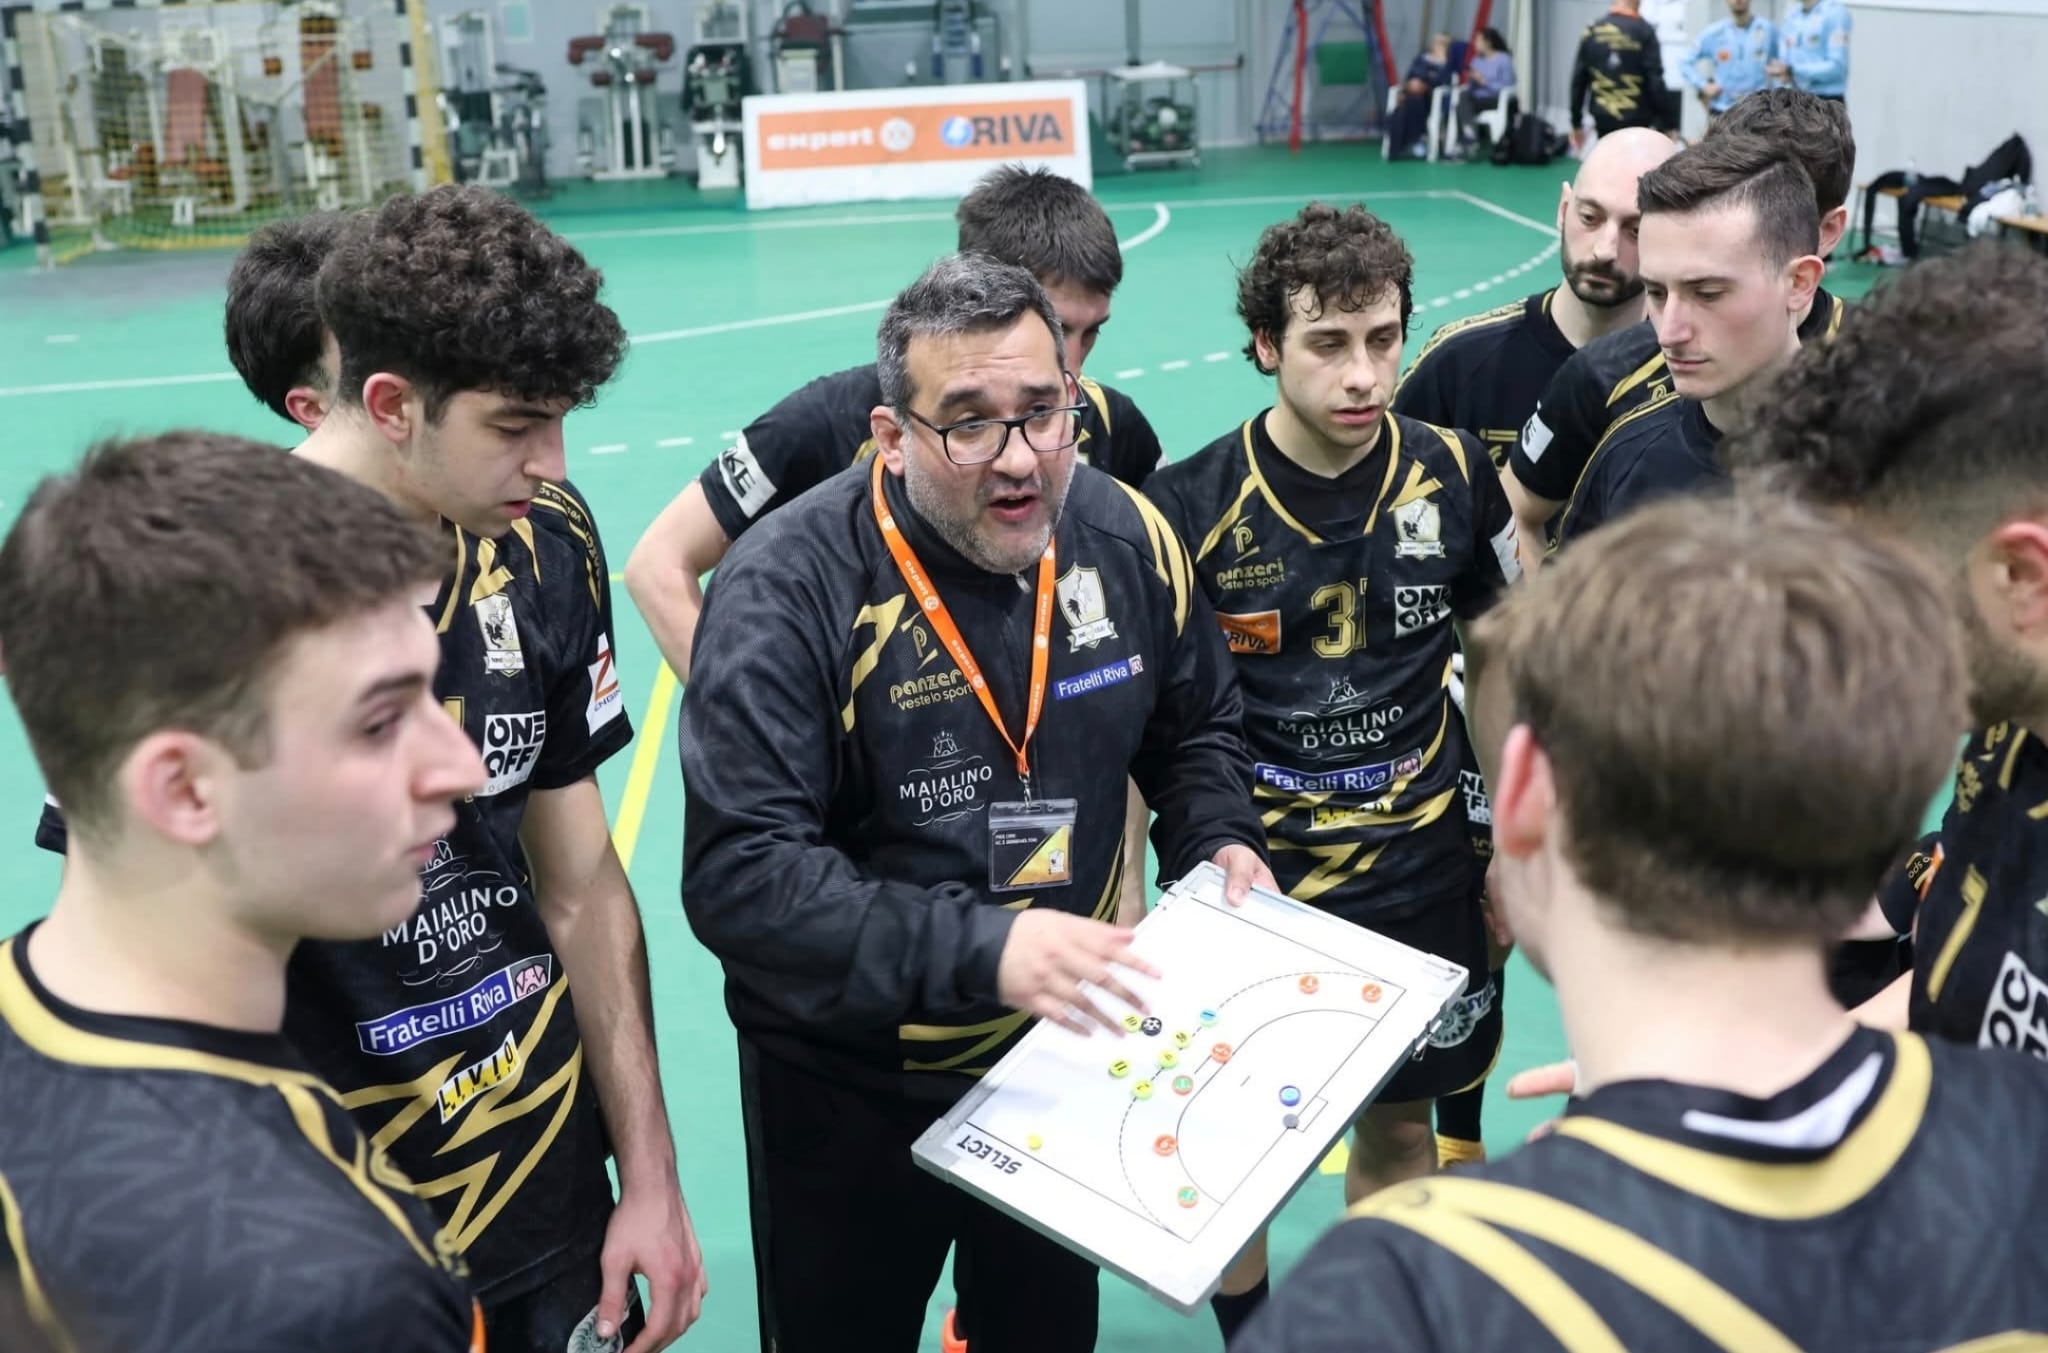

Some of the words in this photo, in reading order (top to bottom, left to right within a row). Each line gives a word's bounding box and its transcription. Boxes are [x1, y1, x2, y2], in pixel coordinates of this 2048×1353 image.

[767, 127, 873, 152] expert
[972, 112, 1064, 147] RIVA
[903, 559, 930, 597] expert
[1397, 586, 1451, 608] ONE
[1397, 605, 1443, 630] OFF
[890, 668, 966, 704] panzer
[1058, 672, 1102, 698] Fratelli
[1103, 663, 1129, 684] Riva
[898, 694, 931, 711] veste
[1277, 705, 1404, 735] MAIALINO
[487, 711, 545, 747] ONE
[1303, 729, 1385, 750] D'ORO
[486, 745, 535, 779] OFF
[1263, 767, 1338, 792] Fratelli
[1344, 771, 1387, 791] Riva
[900, 765, 993, 800] MAIALINO
[921, 784, 976, 814] D'ORO
[382, 885, 518, 947] MAIALINO
[418, 912, 487, 965] D'ORO
[368, 1001, 466, 1050] Fratelli
[470, 983, 507, 1018] Riva
[438, 1040, 514, 1110] LIVIO
[956, 1134, 1023, 1175] SELECT
